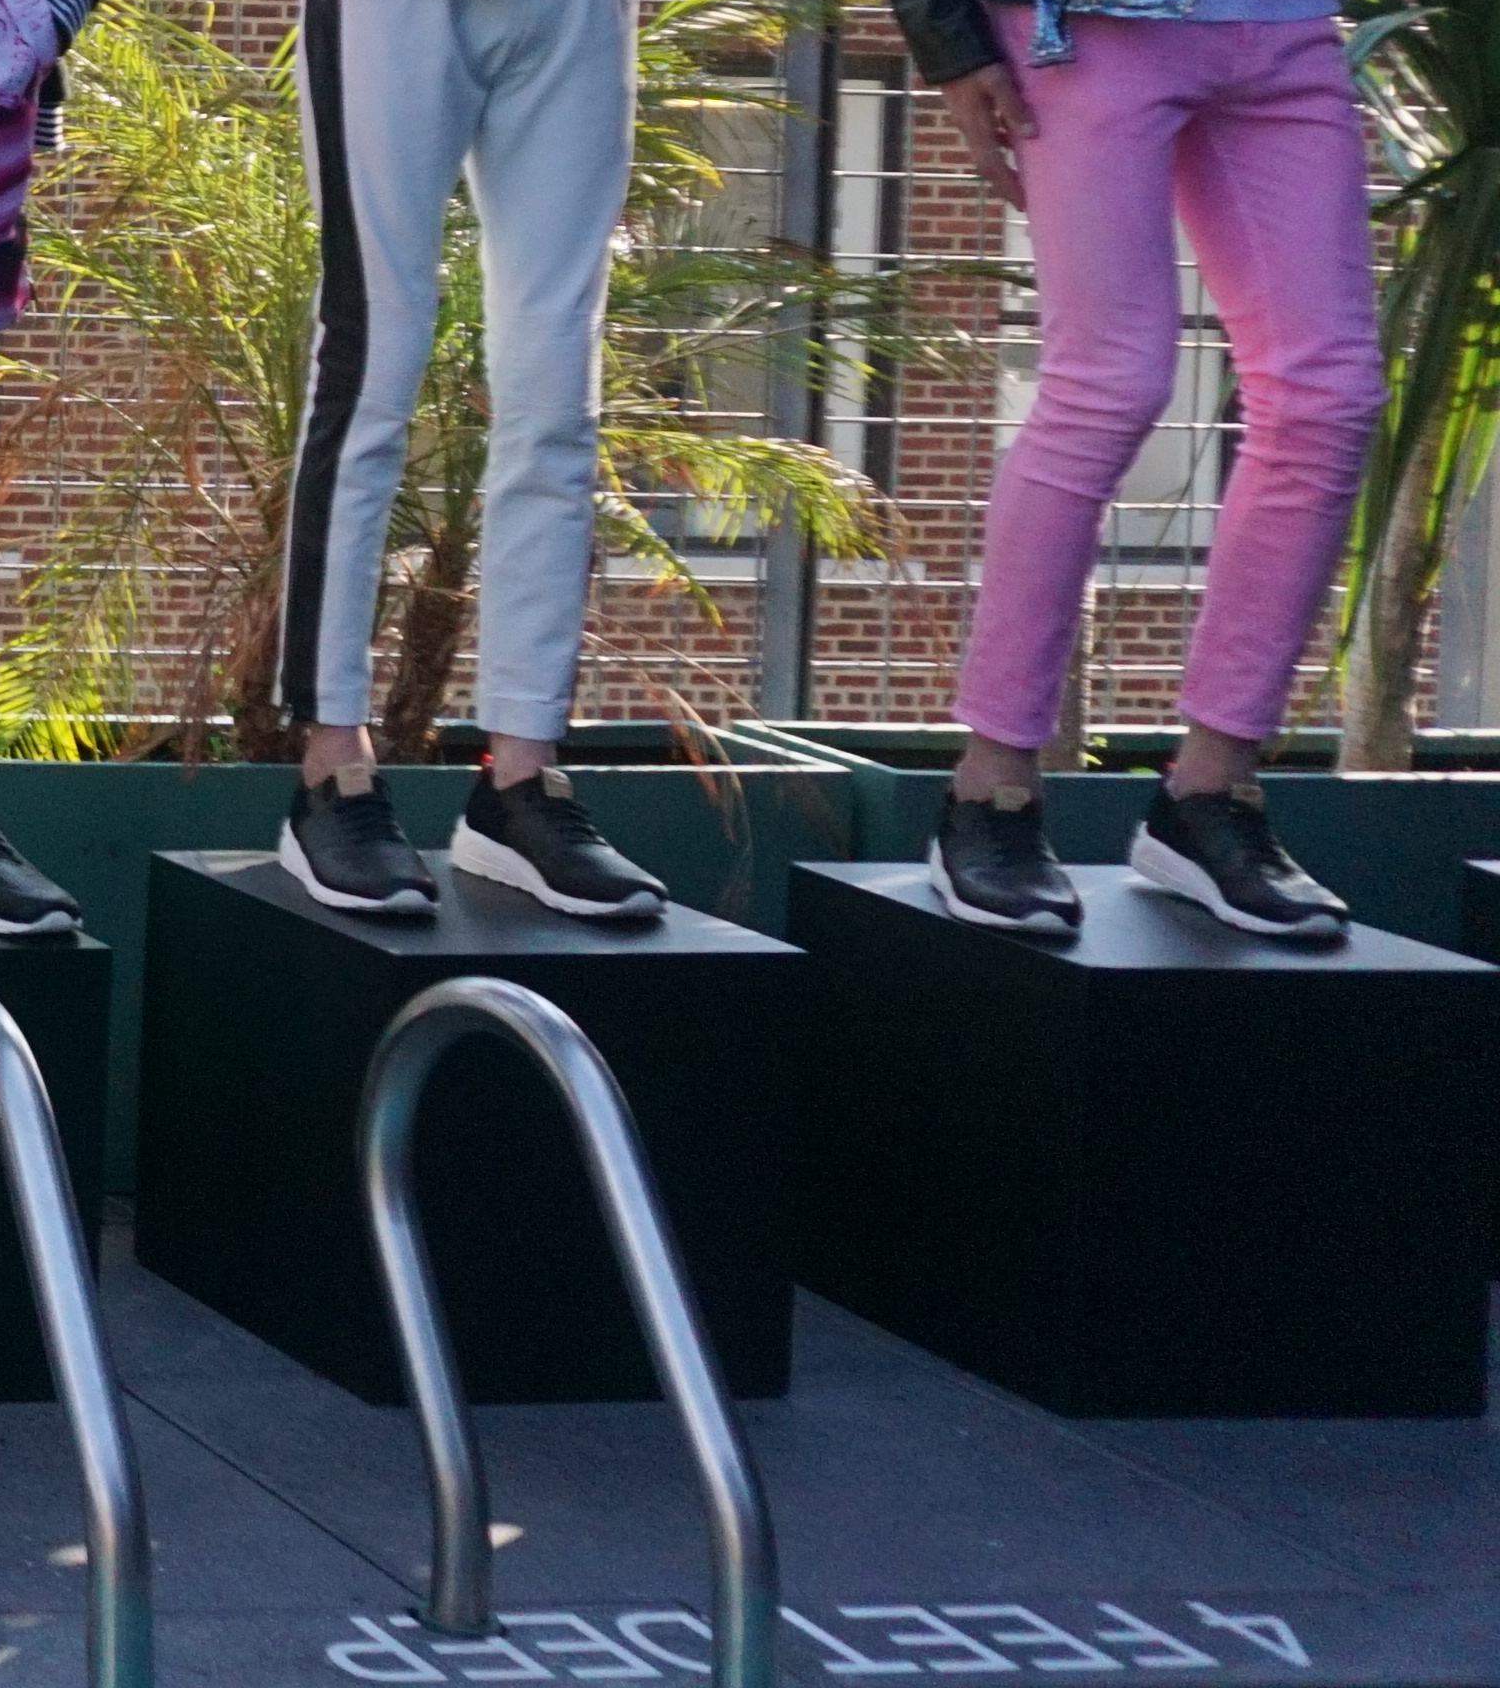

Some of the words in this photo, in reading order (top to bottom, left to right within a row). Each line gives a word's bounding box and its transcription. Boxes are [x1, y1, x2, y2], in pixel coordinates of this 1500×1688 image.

[326, 1612, 712, 1682] DEEP
[779, 1603, 1220, 1674] FEET
[1185, 1600, 1312, 1669] 4
